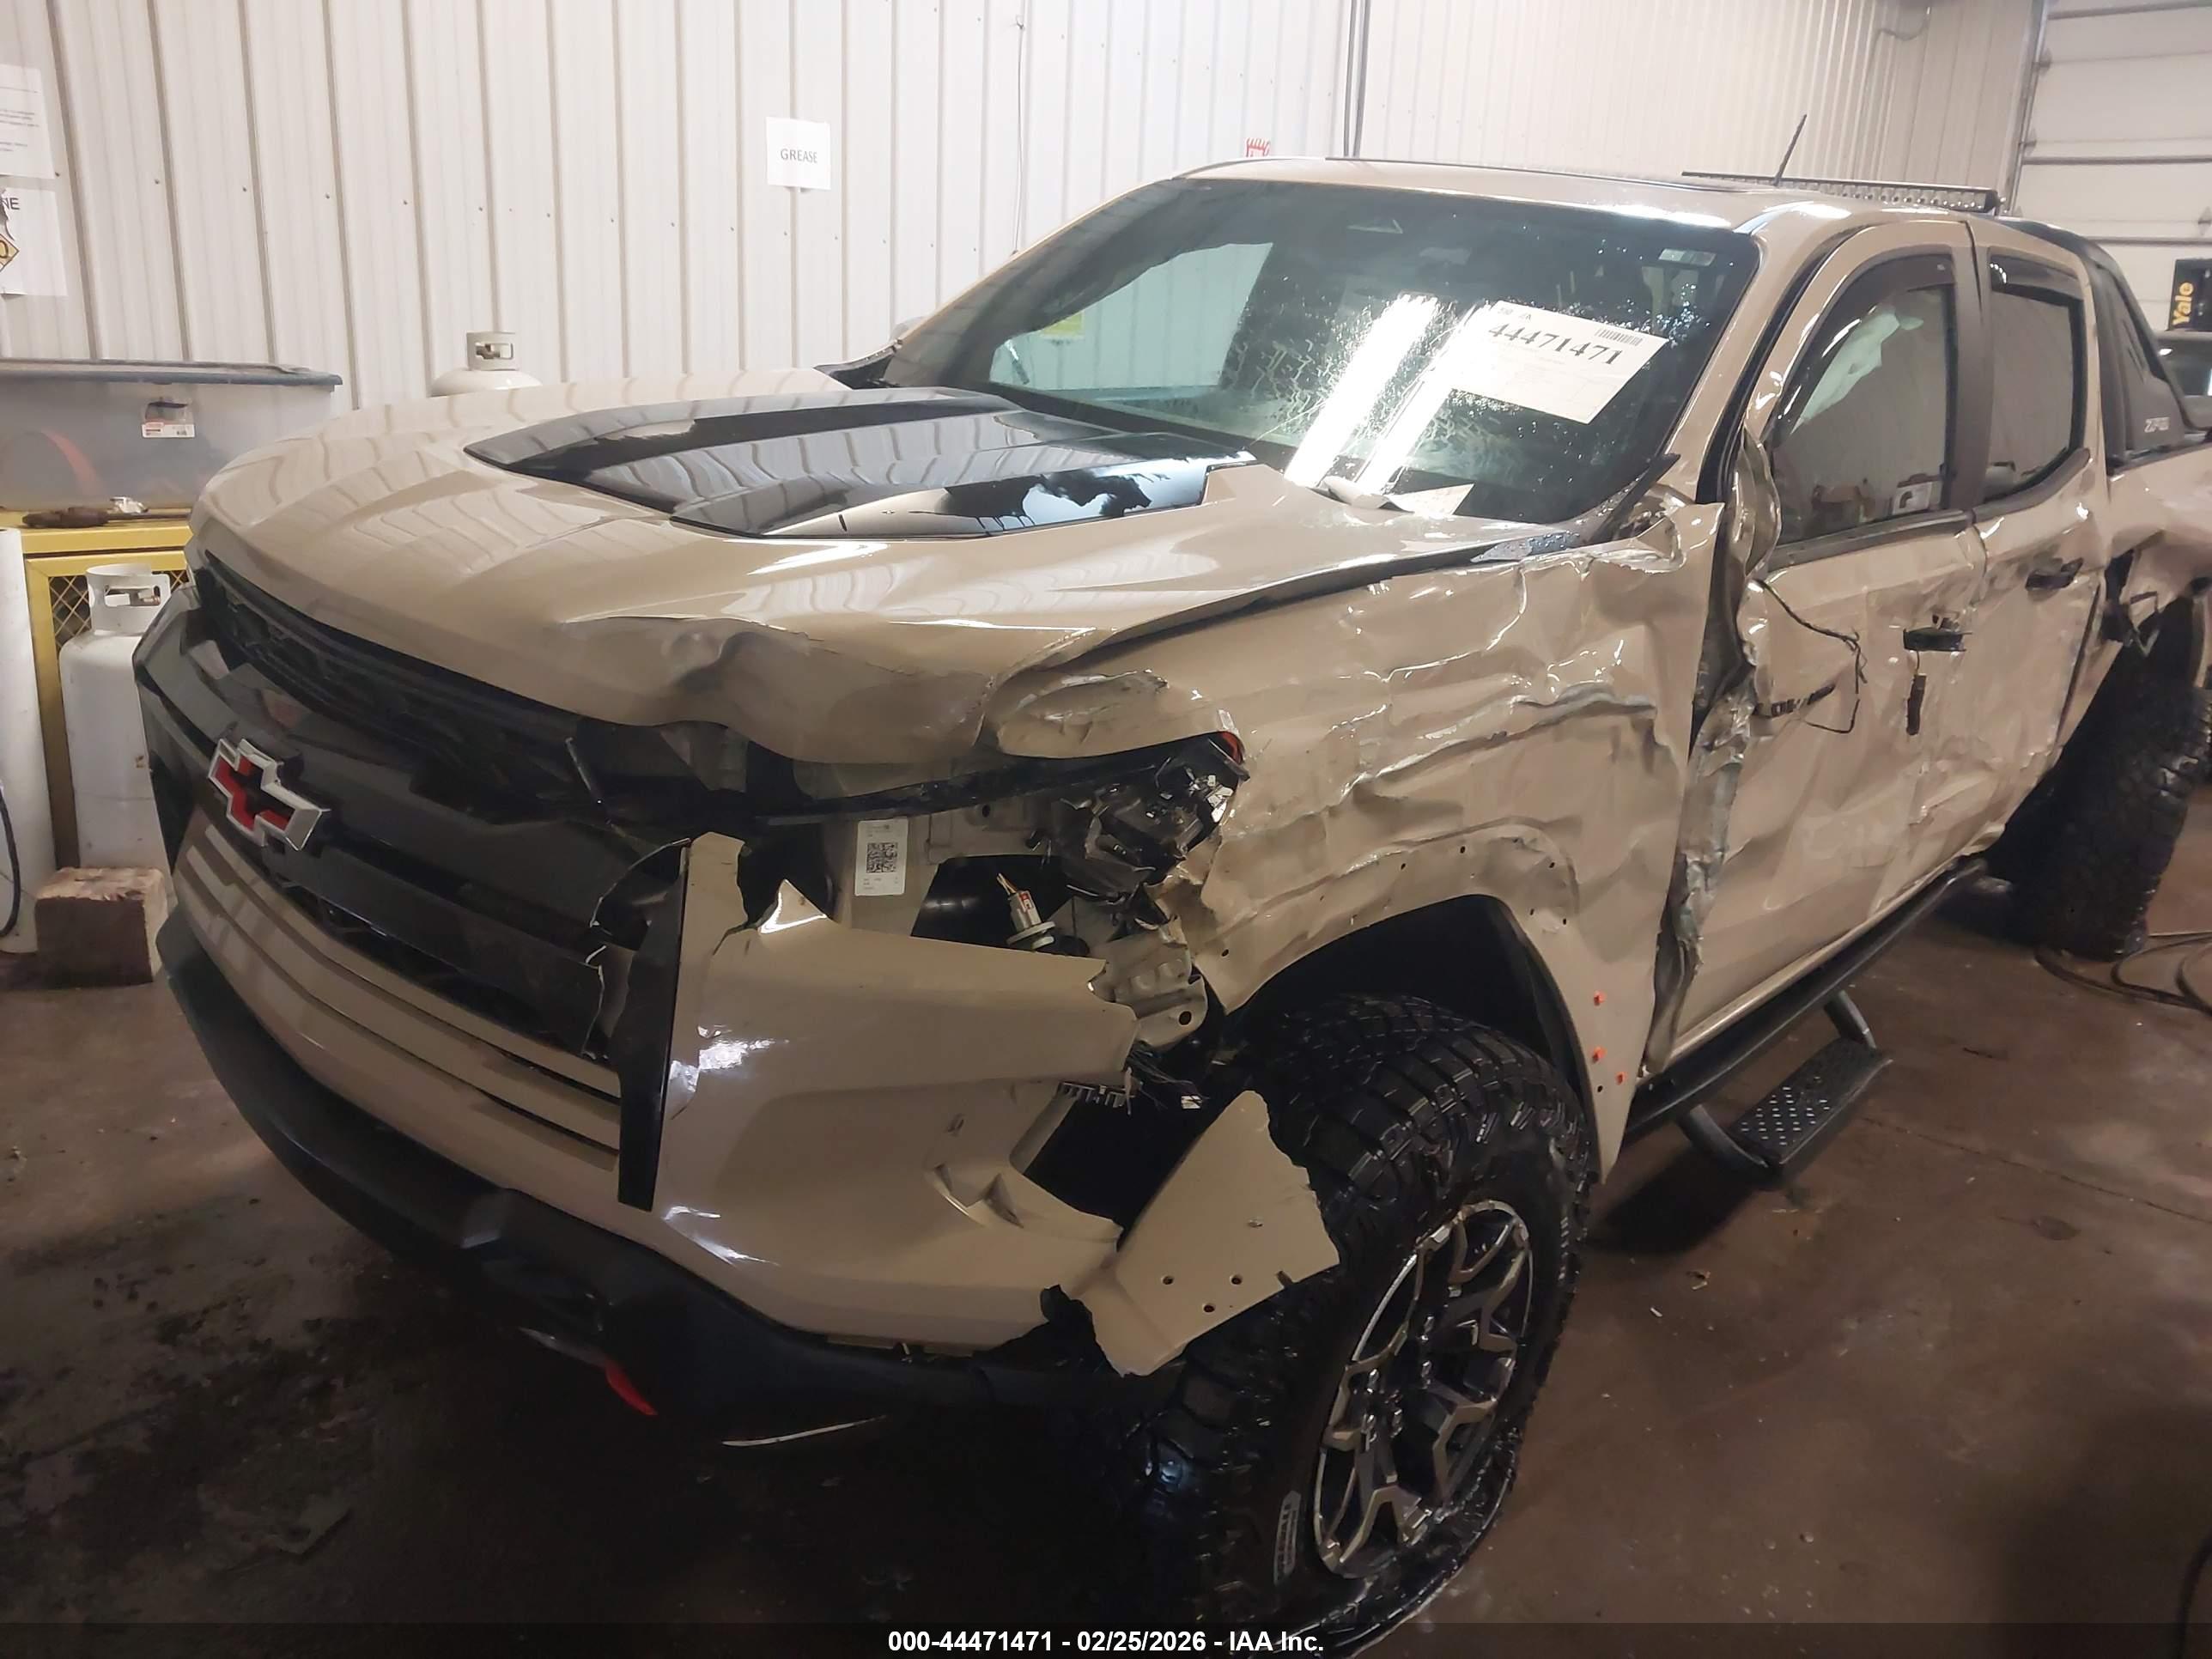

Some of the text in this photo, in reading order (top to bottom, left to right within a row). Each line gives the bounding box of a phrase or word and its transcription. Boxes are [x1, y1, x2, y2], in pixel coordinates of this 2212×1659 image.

[781, 148, 817, 164] GREASE
[2172, 282, 2194, 325] Yale
[1488, 323, 1623, 364] 44471471
